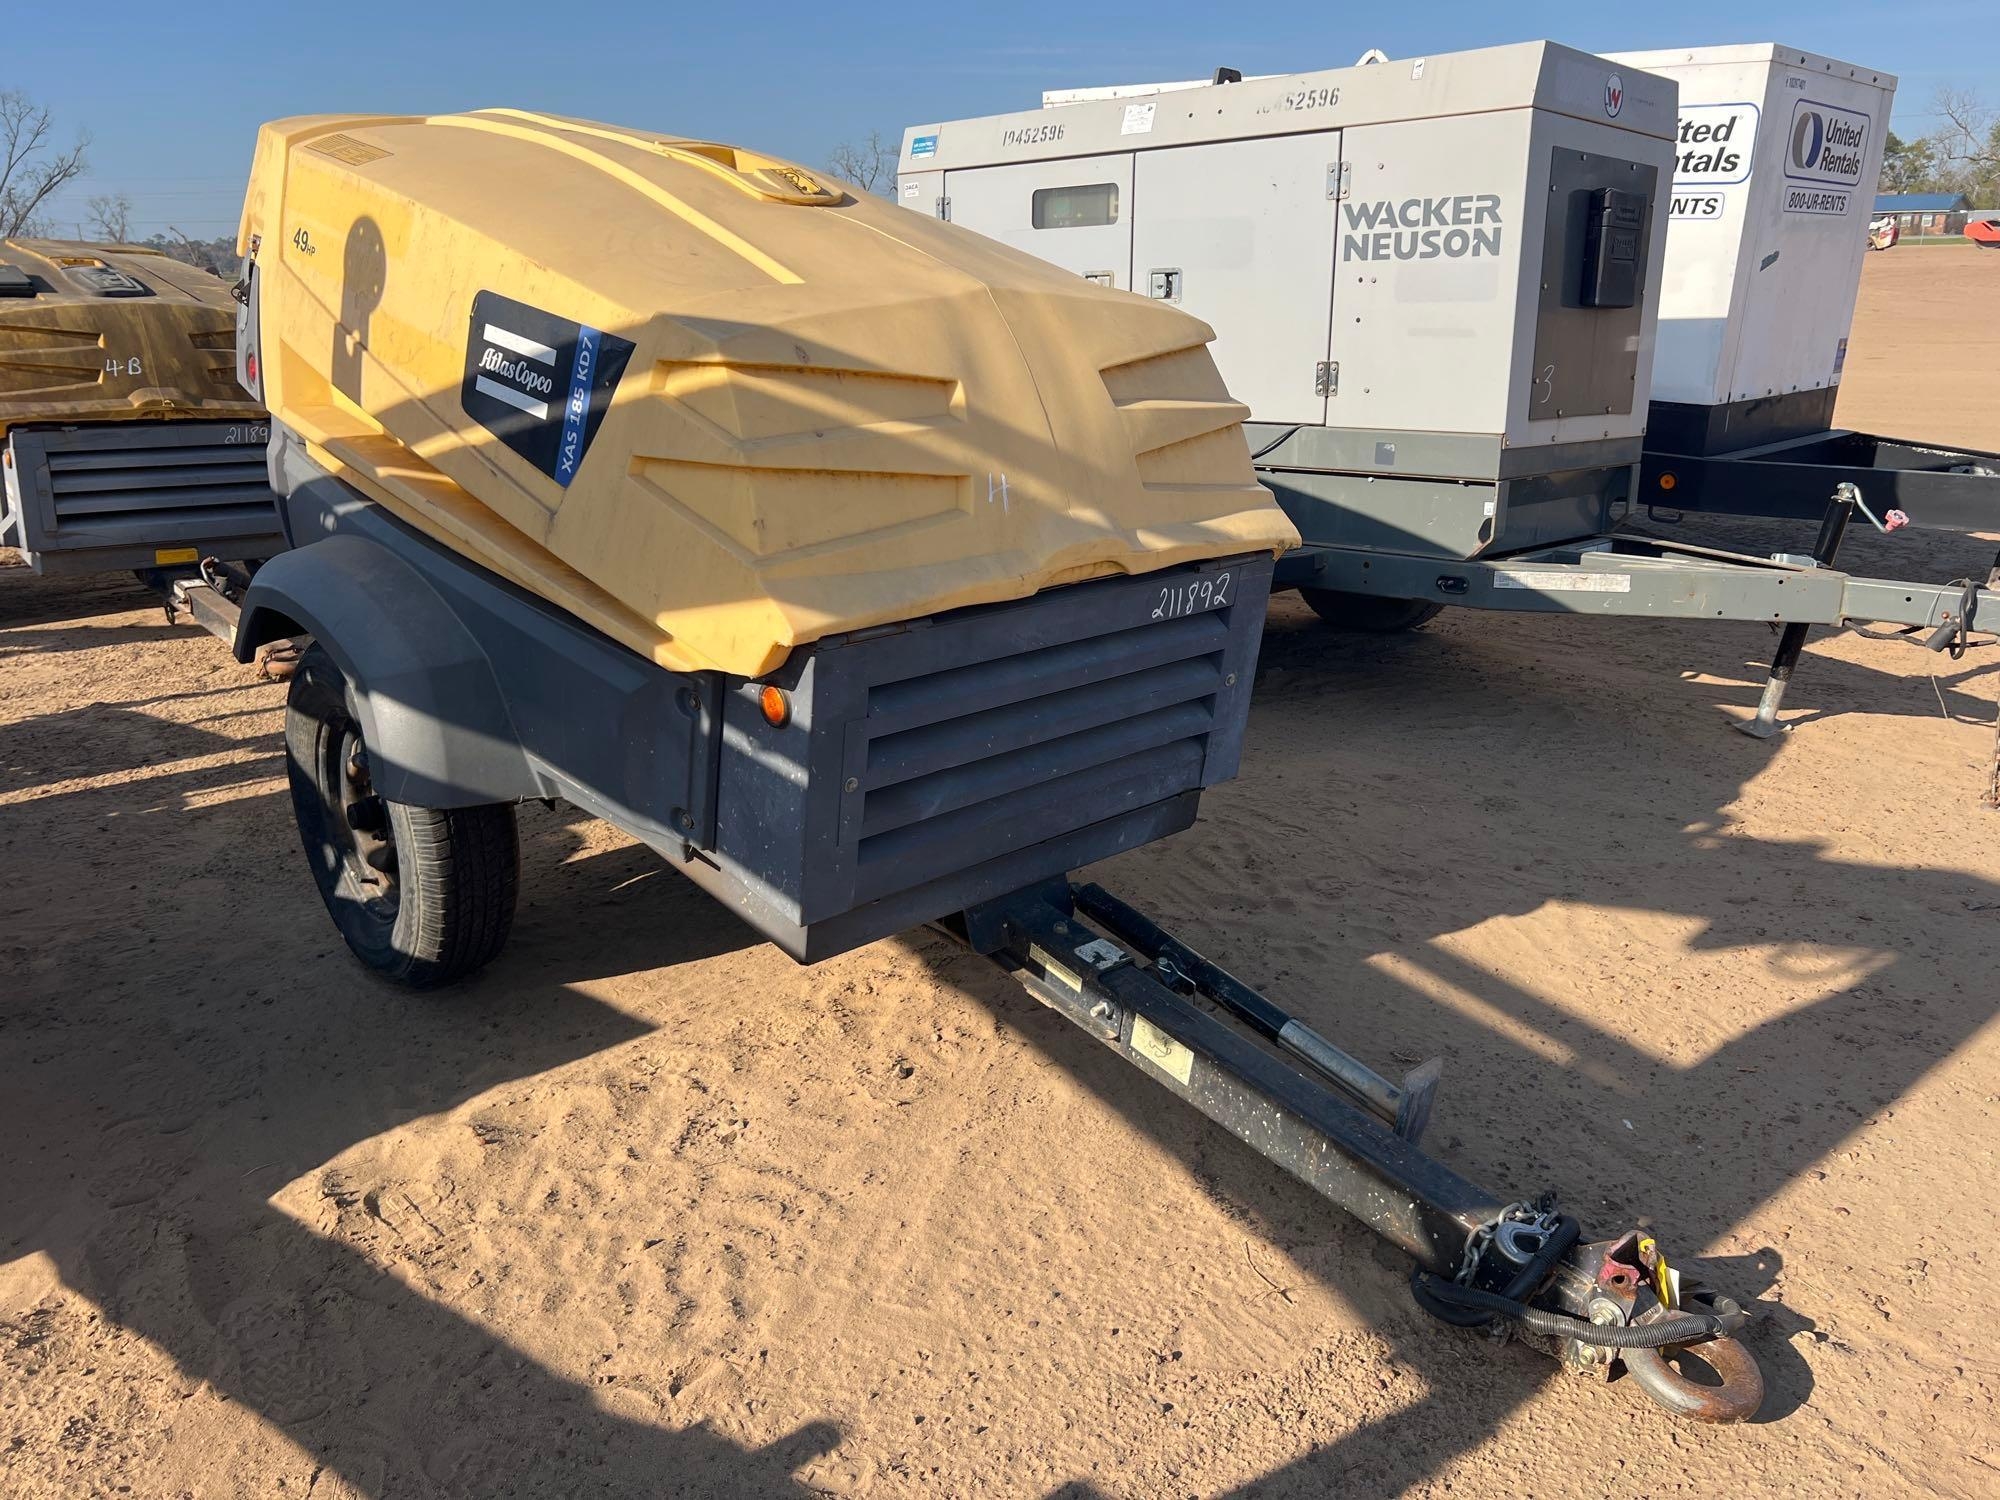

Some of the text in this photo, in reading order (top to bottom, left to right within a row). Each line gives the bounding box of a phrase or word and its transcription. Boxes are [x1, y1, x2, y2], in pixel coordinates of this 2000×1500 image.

[1825, 117, 1865, 148] United
[1819, 146, 1861, 176] Rentals
[1343, 194, 1503, 231] WACKER
[1788, 191, 1847, 212] 800-UR-RENTS
[1343, 226, 1503, 262] NEUSON
[1540, 364, 1555, 404] 3
[561, 336, 593, 474] XAS 185 KD7
[1151, 572, 1231, 619] 211892
